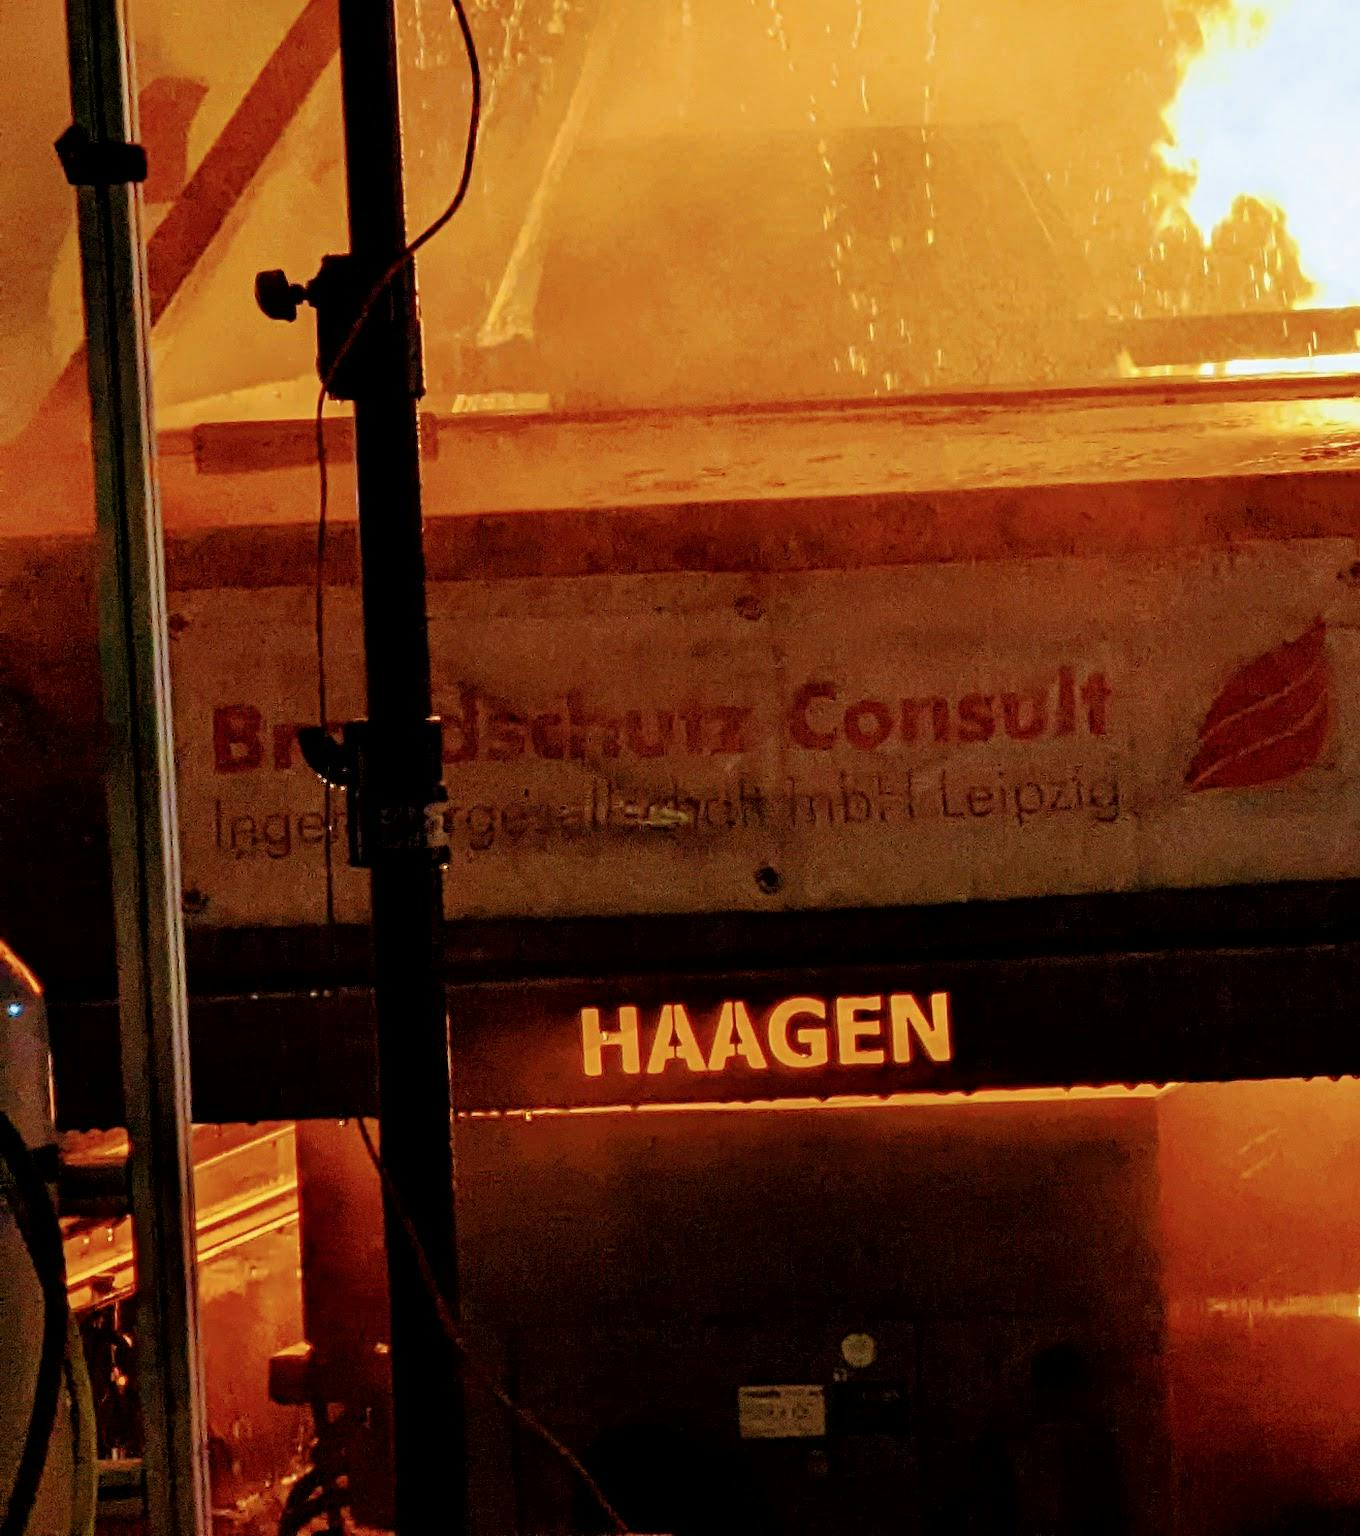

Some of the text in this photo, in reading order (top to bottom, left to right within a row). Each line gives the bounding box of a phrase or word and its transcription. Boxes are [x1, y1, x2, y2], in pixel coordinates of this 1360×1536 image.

[212, 665, 1112, 776] Brdschutz Consult
[942, 764, 1119, 826] Leipzig
[581, 992, 950, 1076] HAAGEN
